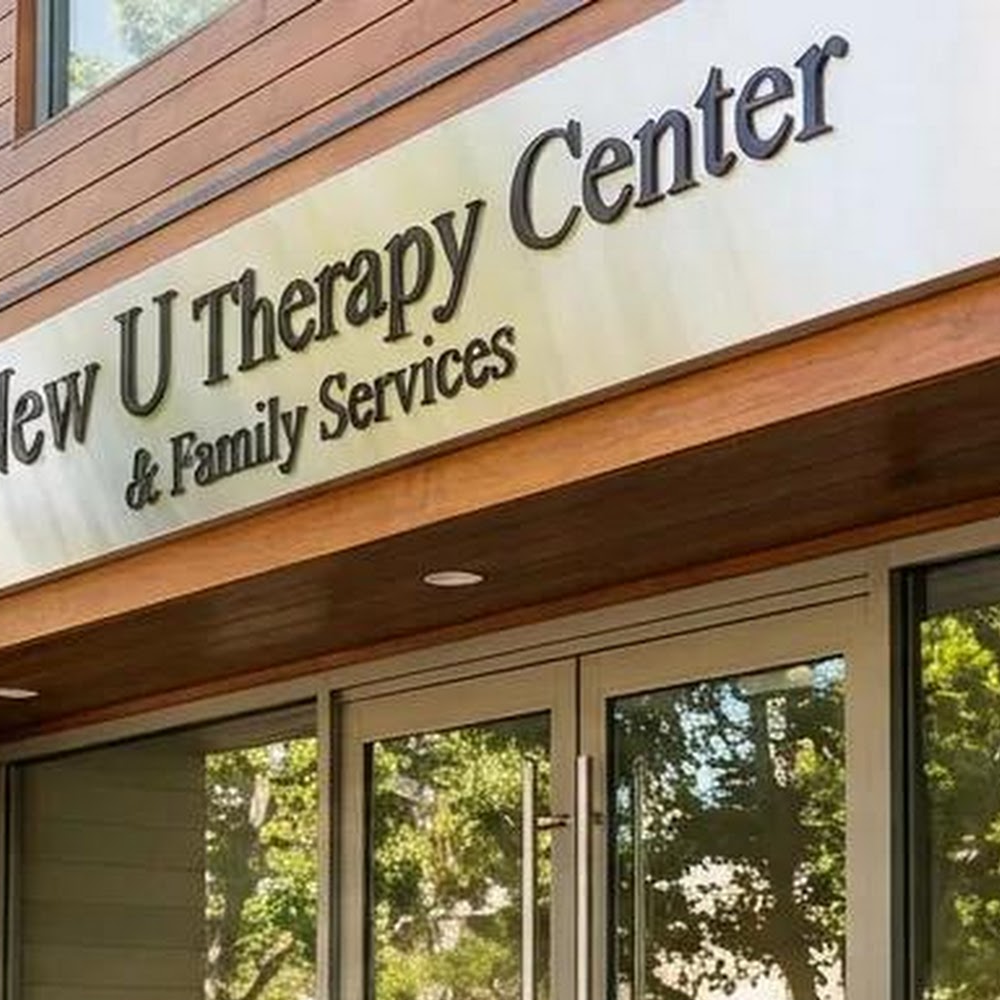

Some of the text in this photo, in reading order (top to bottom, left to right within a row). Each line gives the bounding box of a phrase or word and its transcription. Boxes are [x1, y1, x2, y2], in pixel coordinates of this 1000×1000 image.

[114, 290, 179, 418] U
[193, 199, 487, 387] Therapy
[509, 35, 849, 251] Center
[125, 326, 517, 511] & Family Services
